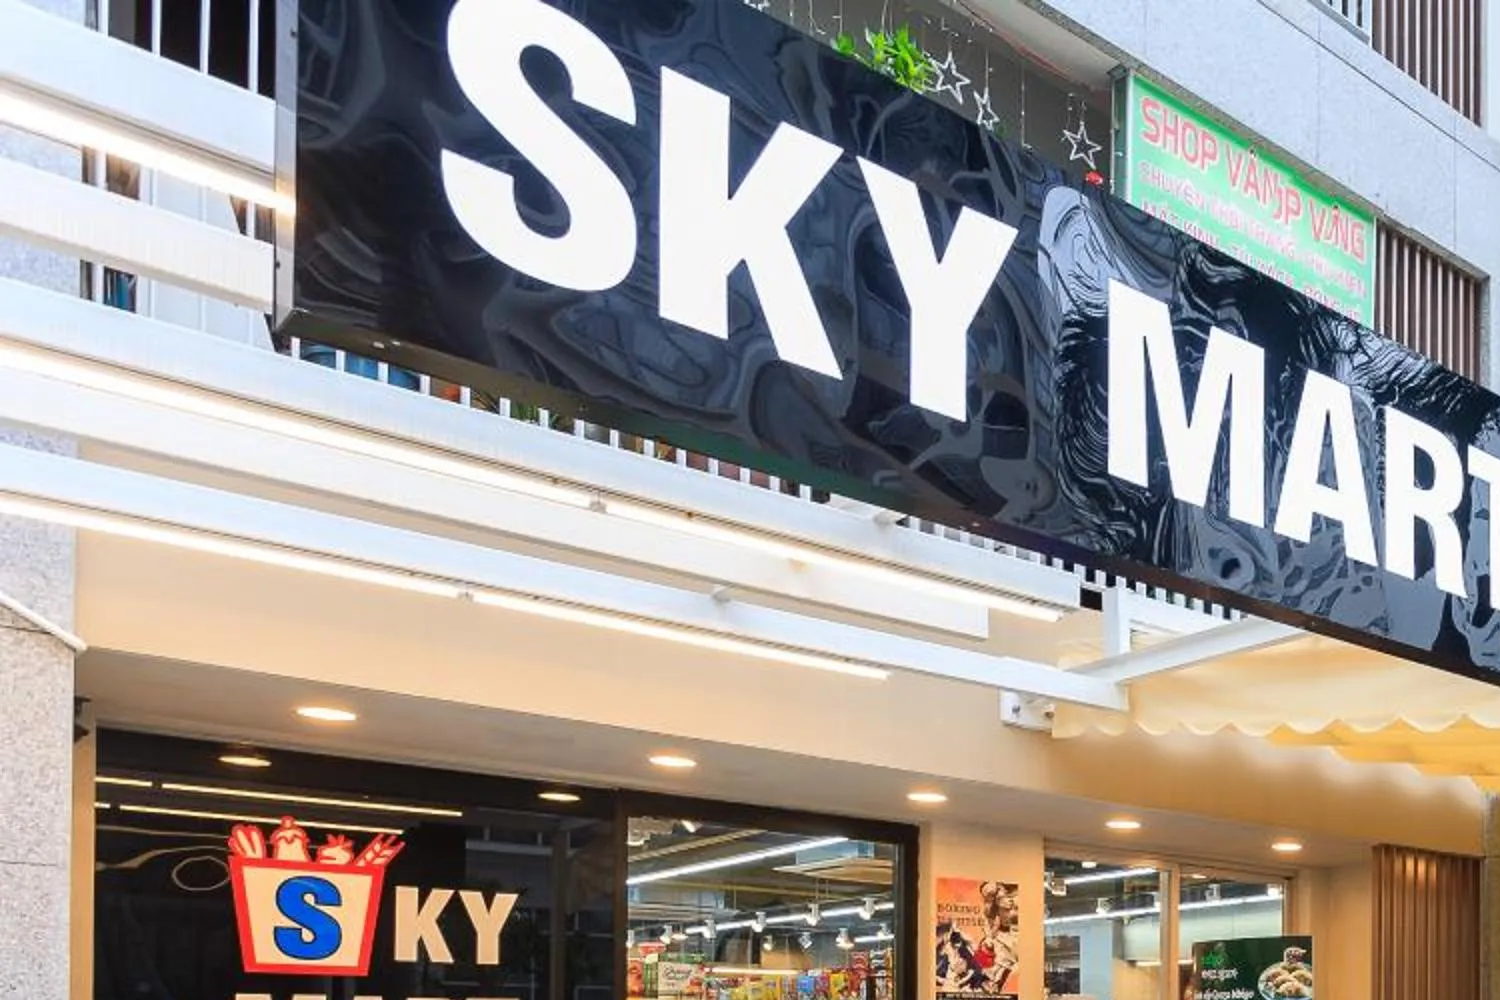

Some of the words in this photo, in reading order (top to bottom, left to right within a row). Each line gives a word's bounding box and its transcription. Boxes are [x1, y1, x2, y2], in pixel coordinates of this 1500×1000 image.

[1141, 97, 1219, 170] SHOP
[440, 0, 1018, 423] SKY
[274, 875, 519, 965] SKY
